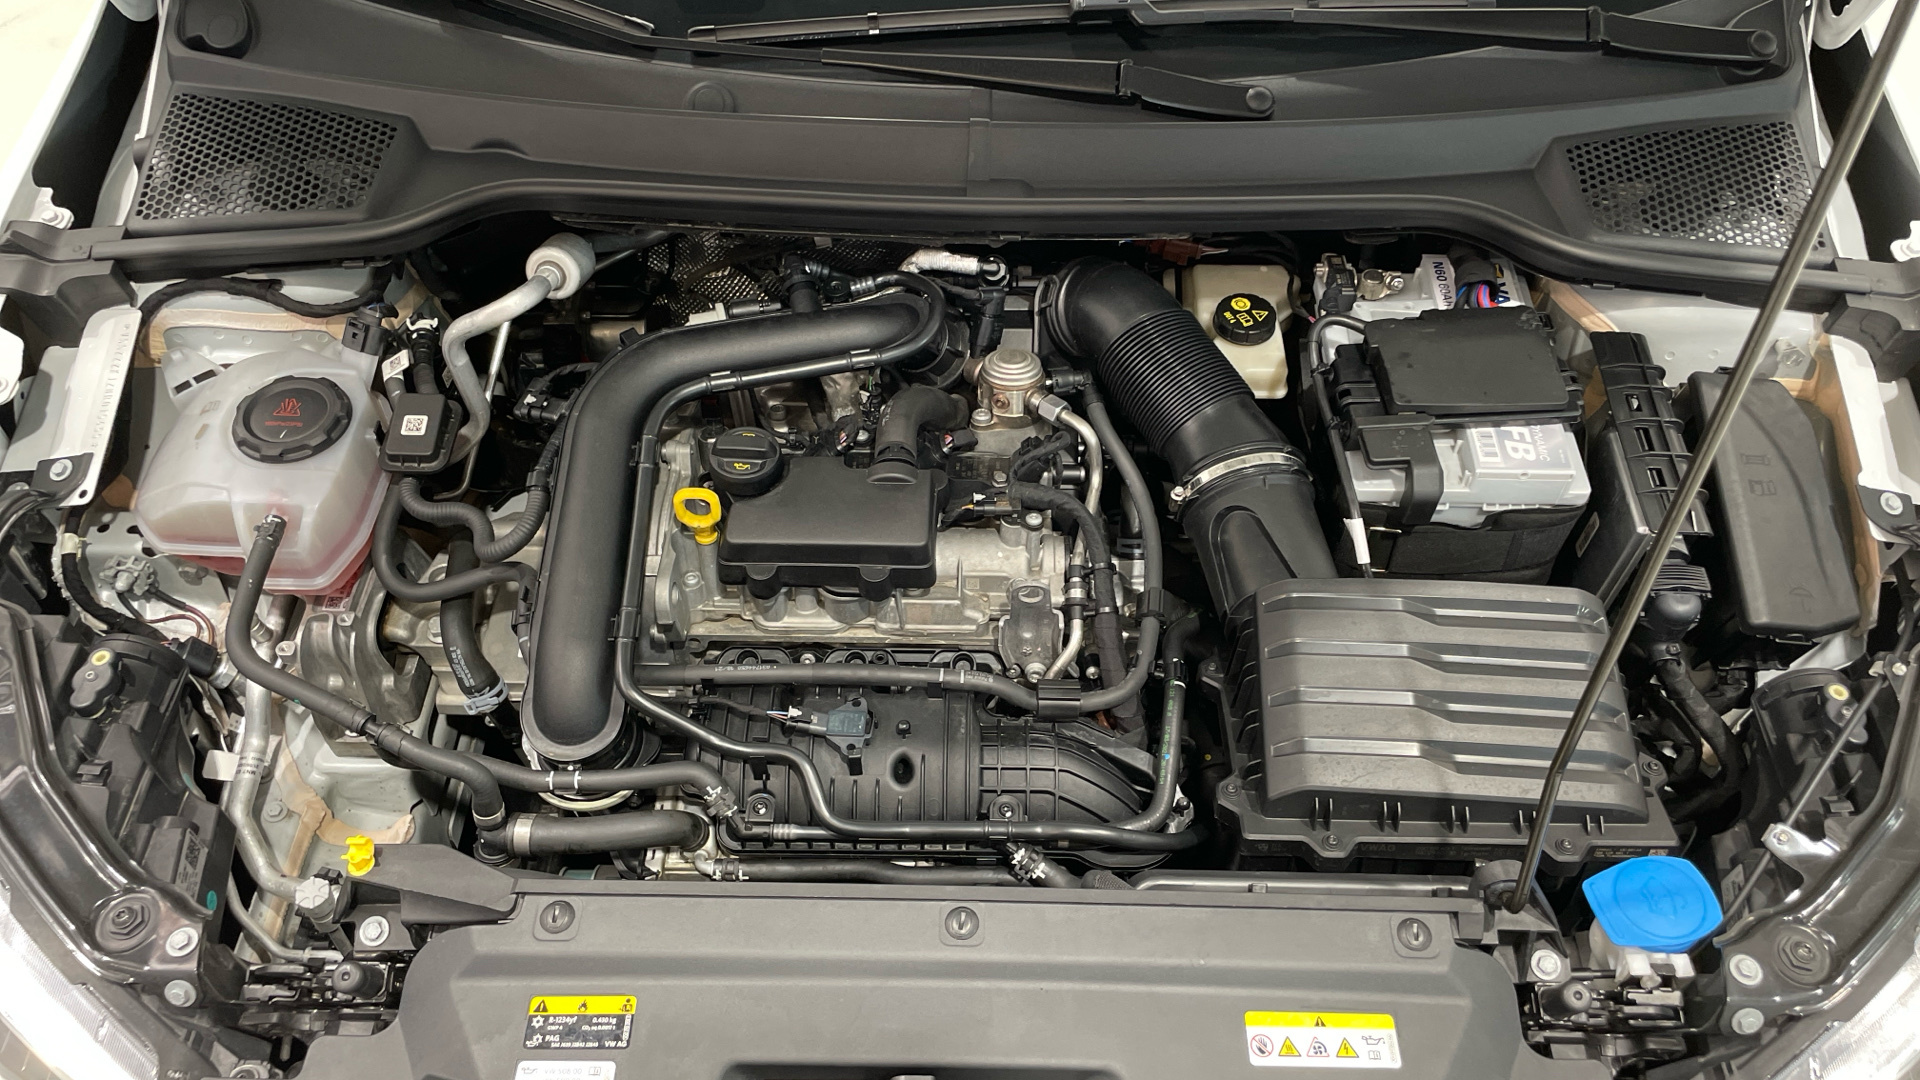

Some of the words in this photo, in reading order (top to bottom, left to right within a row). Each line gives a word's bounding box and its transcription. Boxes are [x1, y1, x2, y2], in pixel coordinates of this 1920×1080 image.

[1432, 261, 1447, 282] N60
[1438, 283, 1454, 307] 60Ah
[545, 1034, 560, 1042] PAG
[604, 1040, 616, 1048] VW
[616, 1040, 628, 1048] AG
